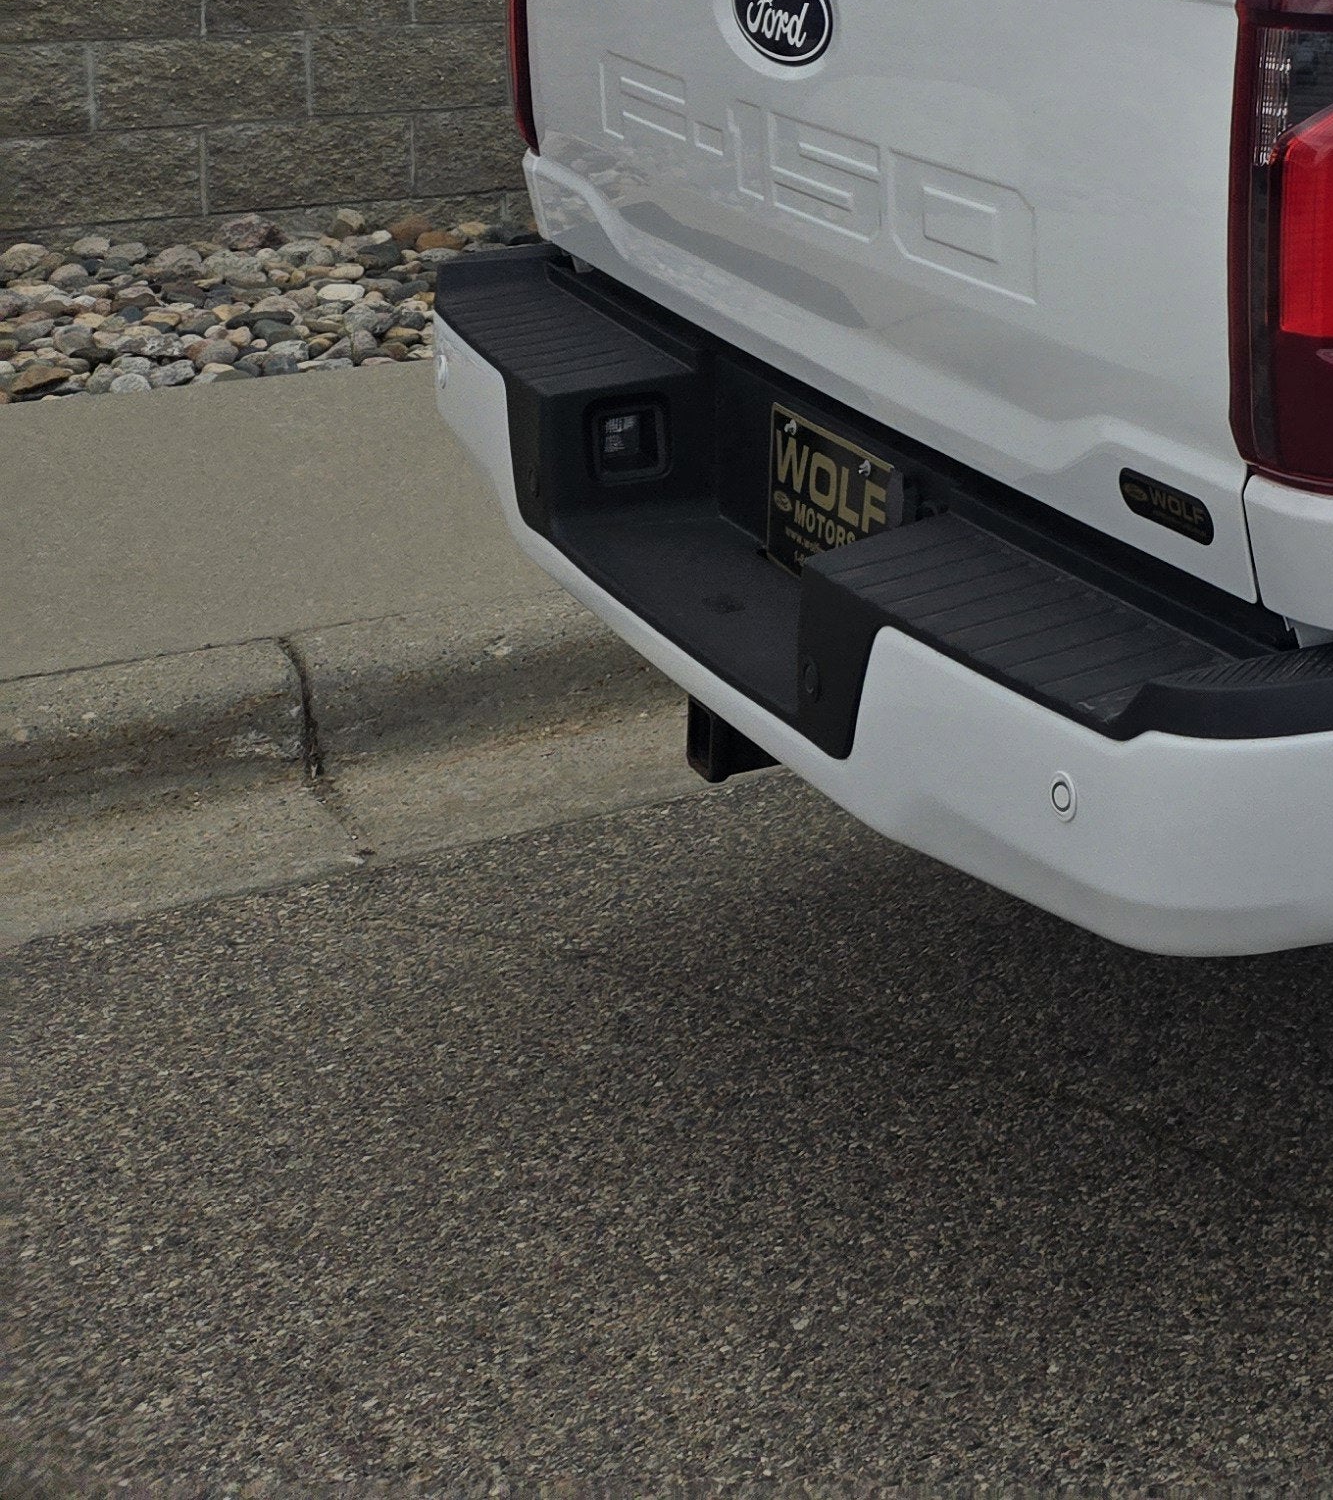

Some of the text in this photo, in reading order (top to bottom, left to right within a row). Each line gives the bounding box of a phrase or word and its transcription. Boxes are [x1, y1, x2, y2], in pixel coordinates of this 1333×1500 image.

[600, 50, 1037, 305] F-150
[776, 429, 886, 533] WOLF
[1148, 486, 1204, 525] WOLF
